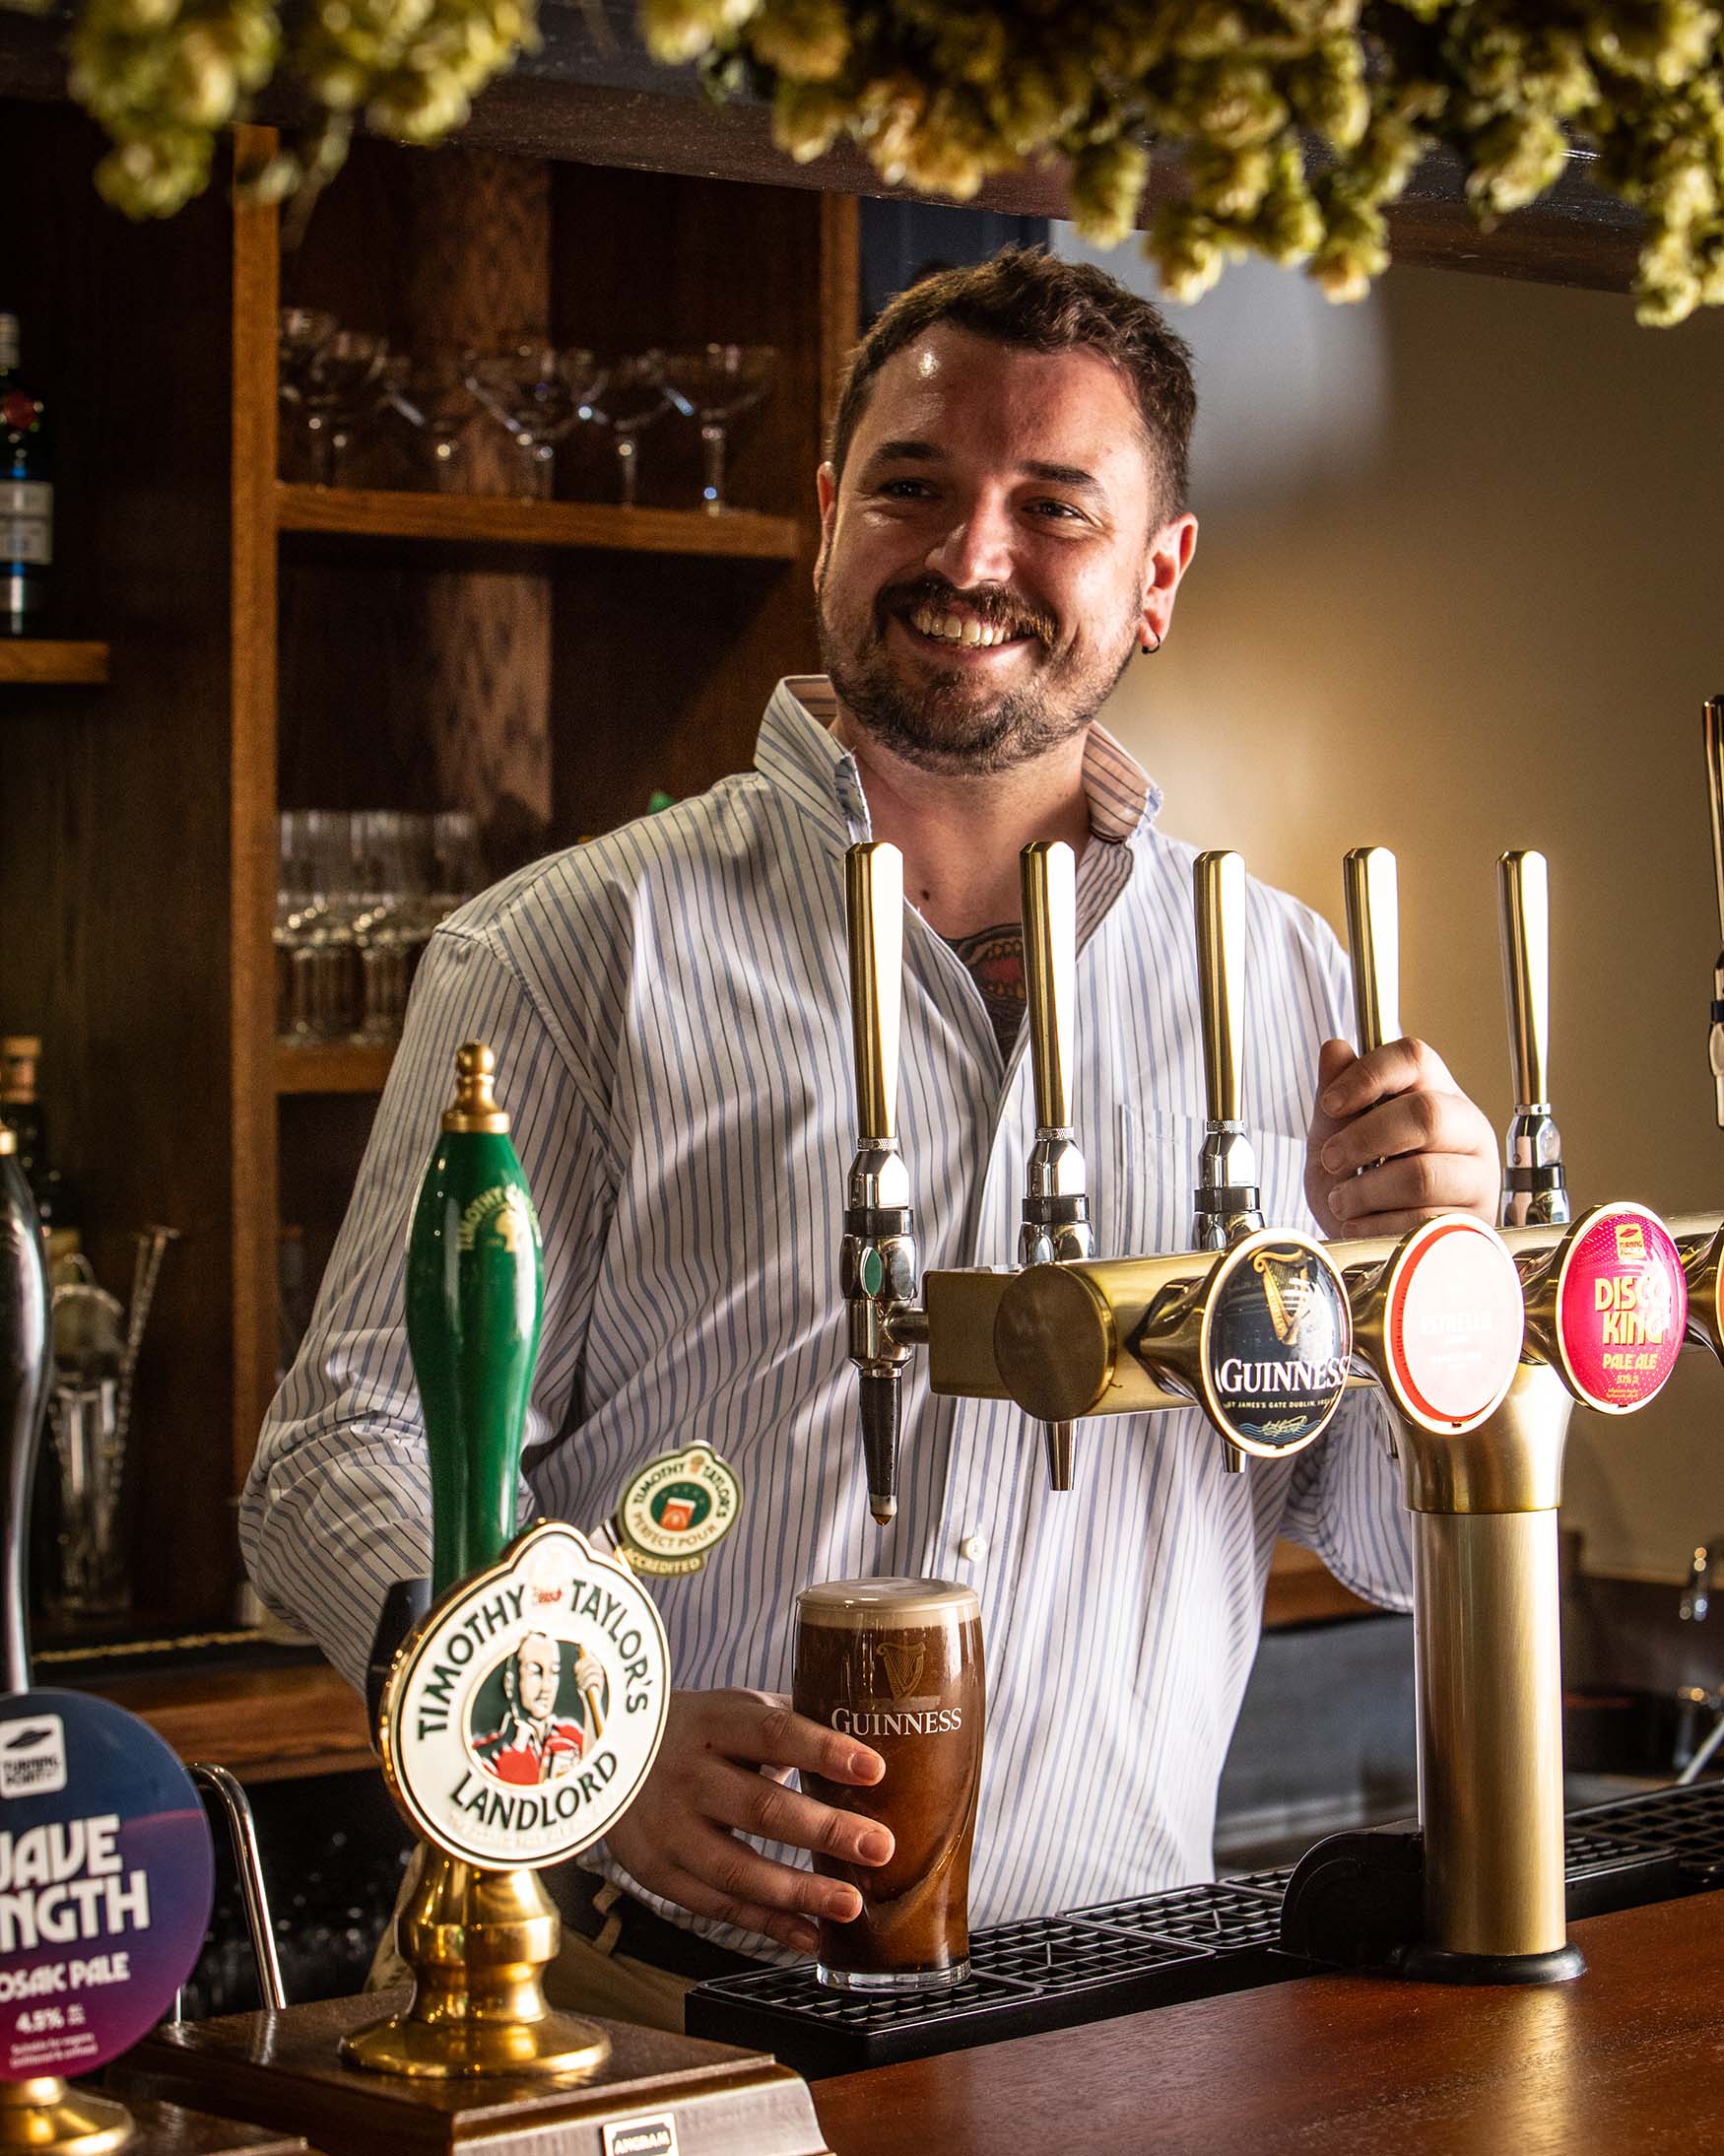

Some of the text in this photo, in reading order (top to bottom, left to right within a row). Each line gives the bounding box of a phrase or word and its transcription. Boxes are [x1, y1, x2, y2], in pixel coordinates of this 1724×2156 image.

[1595, 1277, 1668, 1312] DISCO
[1603, 1312, 1665, 1346] KING
[1221, 1356, 1349, 1392] GUINNESS
[1603, 1353, 1658, 1370] PALE ALE
[1269, 1400, 1287, 1409] GATE
[633, 1462, 686, 1506] TIMOTHY
[677, 1523, 717, 1547] POUR
[418, 1579, 654, 1741] TIMOTHY TAYLOR'S
[831, 1707, 962, 1736] GUINNESS
[450, 1750, 619, 1832] LANDLORD
[68, 1951, 131, 1989] PALE
